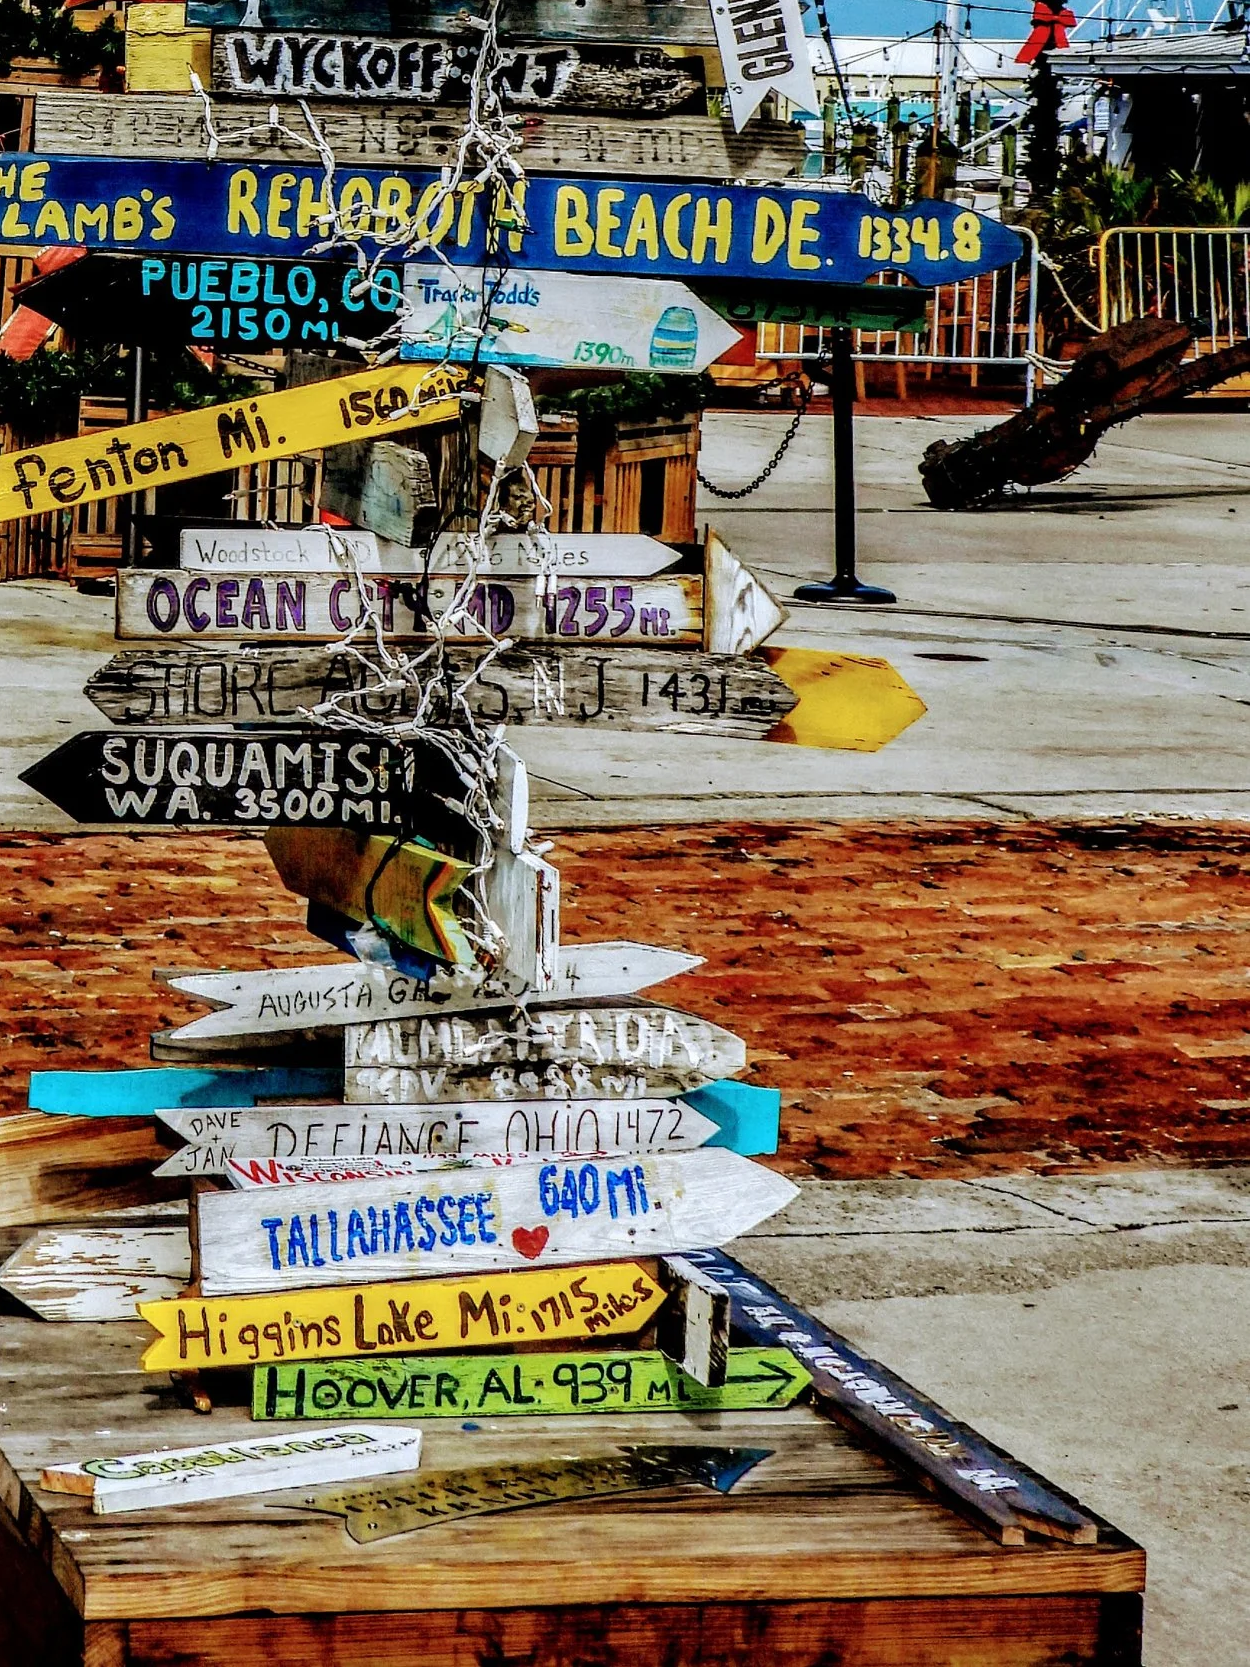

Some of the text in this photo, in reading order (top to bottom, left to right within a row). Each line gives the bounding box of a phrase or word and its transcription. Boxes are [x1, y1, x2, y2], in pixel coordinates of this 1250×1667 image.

[1, 189, 176, 242] LAMB'S
[227, 168, 527, 253] REHOBOTH
[555, 185, 732, 265] BEACH
[859, 212, 981, 263] 1334.8
[141, 260, 399, 313] PUEBLO, CO
[191, 305, 291, 340] 2150
[196, 540, 309, 564] Woodstock
[518, 542, 590, 566] Mles
[147, 577, 306, 632] OCEAN
[102, 737, 414, 794] SUQUAMISH
[234, 788, 334, 821] 3500
[257, 981, 373, 1018] AUGUSTA
[190, 1112, 243, 1136] DAVE
[616, 1108, 684, 1145] 1472
[185, 1145, 237, 1171] JAN
[539, 1163, 601, 1220] 640
[262, 1191, 497, 1271] TALLAHASSEE
[177, 1307, 340, 1360] Higgins
[265, 1366, 469, 1417] HOOVER,
[553, 1361, 633, 1405] 939
